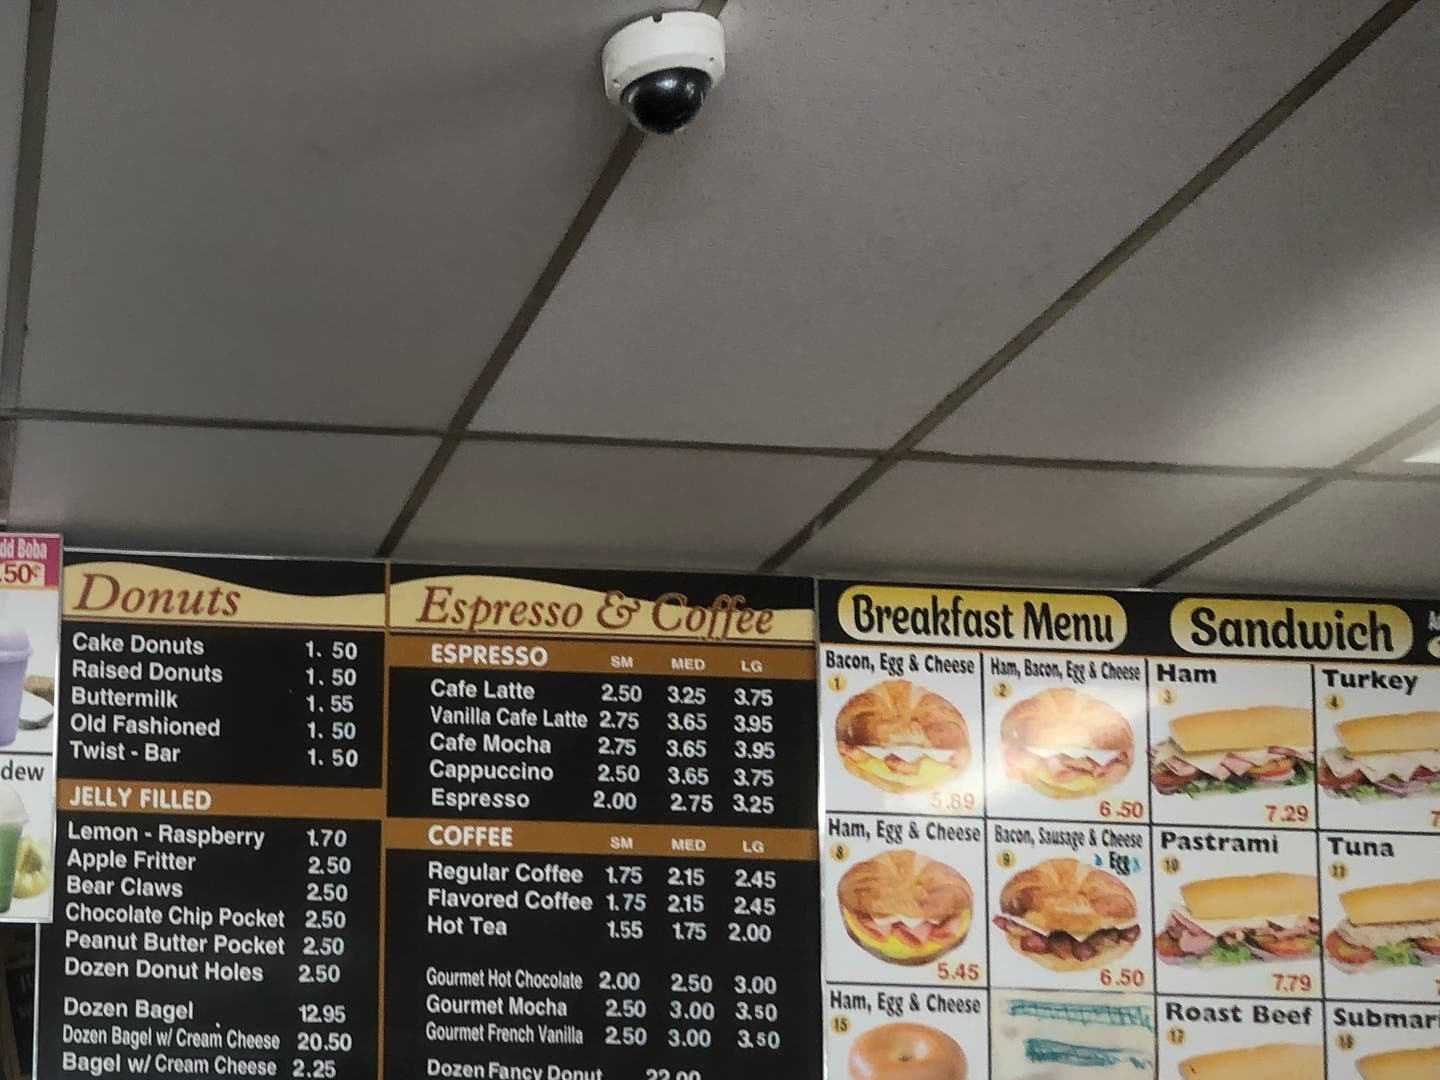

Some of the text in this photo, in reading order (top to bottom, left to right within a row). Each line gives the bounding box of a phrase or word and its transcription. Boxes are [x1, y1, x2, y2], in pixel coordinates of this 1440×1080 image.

[18, 539, 48, 560] Boba
[73, 573, 241, 617] Donuts
[416, 585, 774, 640] Espresso & Coffee
[851, 594, 1115, 644] Breakfast Menu
[1190, 607, 1394, 653] Sandwich
[72, 631, 205, 656] Cake Donuts
[431, 643, 763, 673] ESPRESSO SM MED LG
[825, 650, 975, 676] Bacon, Egg & Cheese
[72, 659, 224, 683] Raised Donuts
[1156, 663, 1217, 684] Ham
[1322, 668, 1418, 695] Turkey
[71, 686, 178, 709] Buttermilk
[431, 678, 774, 708] Cafe Latte 2.50 3.25 3.75
[70, 713, 221, 738] Old Fashioned
[430, 759, 775, 788] Cappuccino 2.50 3.65 3.75
[69, 786, 211, 811] JELLY FILLED
[931, 792, 976, 810] 5.89
[1099, 800, 1144, 819] 6.50
[1265, 804, 1309, 823] 7.29
[428, 825, 513, 848] COFFEE
[828, 818, 981, 844] Ham, Egg & Cheese
[1160, 831, 1279, 854] Pastrami
[1327, 836, 1395, 857] Tuna
[67, 848, 352, 875] Apple Fritter 2.50
[427, 861, 777, 889] Regular Coffee 1.75 2.15 2.45
[66, 875, 349, 901] Bear Claws 2.50
[65, 902, 346, 930] Chocolate Chip Pocket 2.50
[937, 963, 981, 982] 5.45
[1272, 973, 1313, 994] 7.79
[1165, 1002, 1313, 1027] Roast Beef
[62, 1024, 352, 1052] Dozen Bagel w/ Cream Cheese 20.50
